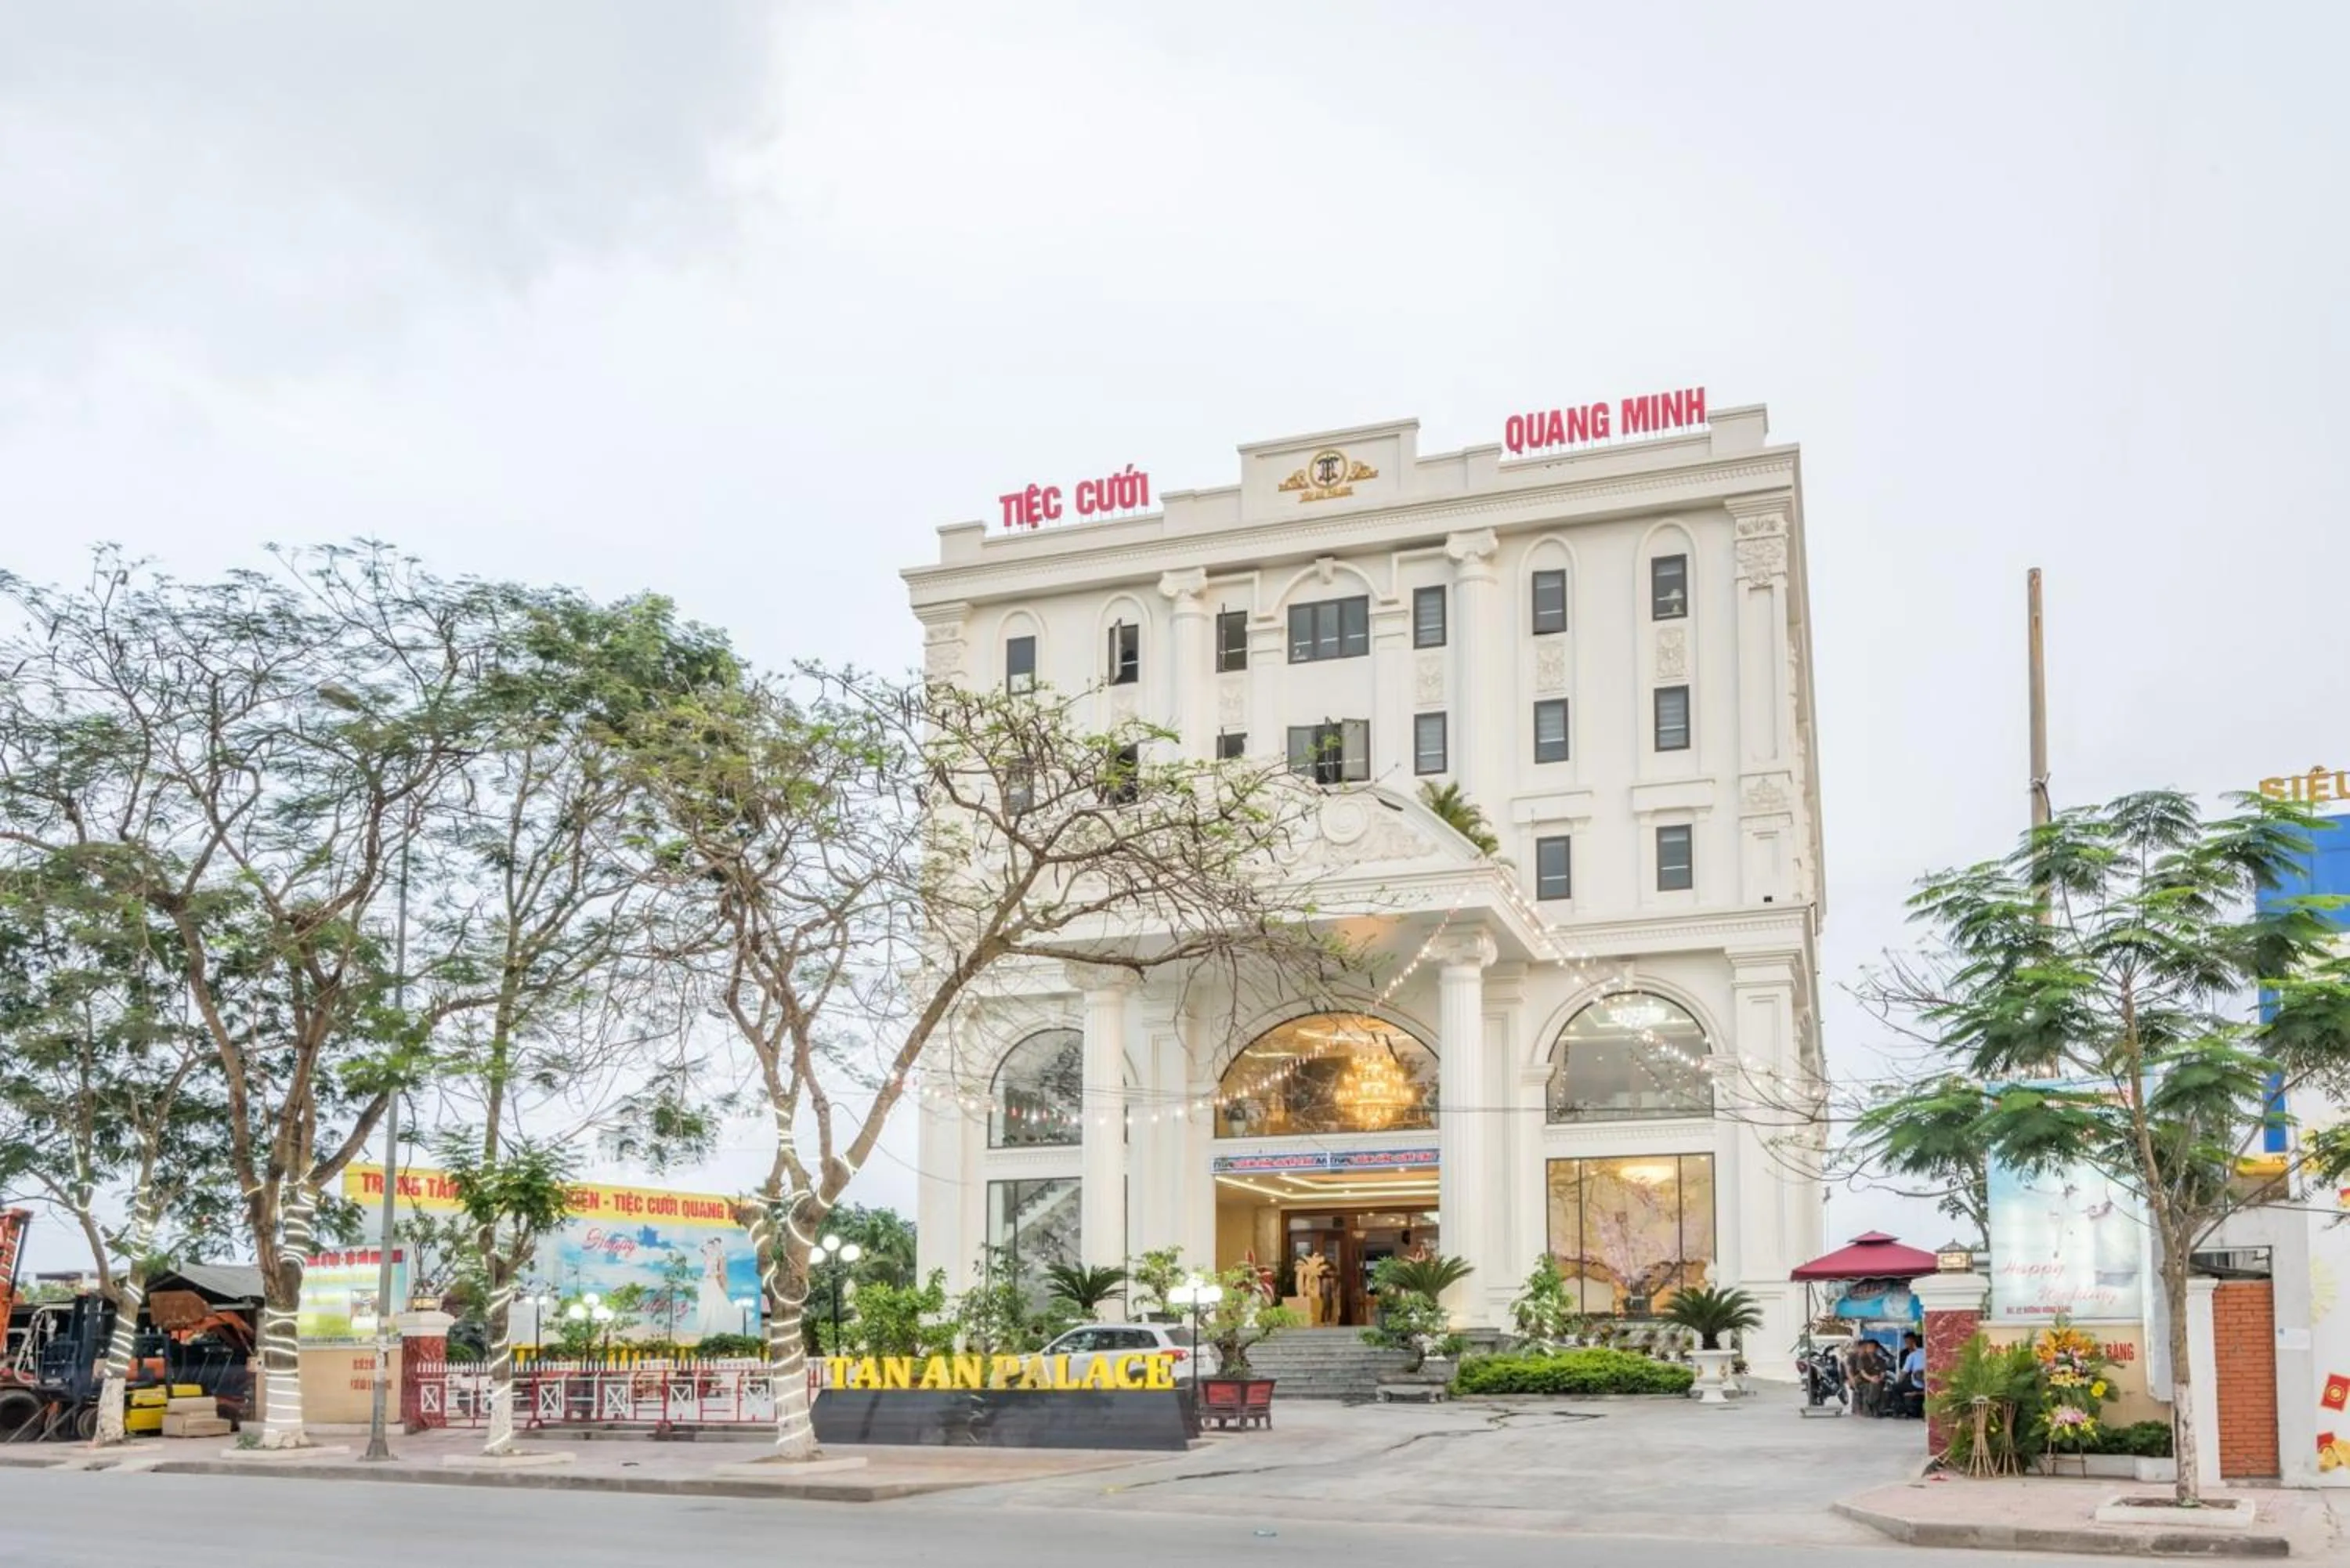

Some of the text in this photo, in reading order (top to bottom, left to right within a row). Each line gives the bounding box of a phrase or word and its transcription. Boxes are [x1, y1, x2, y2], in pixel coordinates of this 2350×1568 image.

[1505, 386, 1705, 454] QUANG MINH
[999, 463, 1149, 529] TIỆC CƯỚI
[361, 1172, 421, 1197] TRNG
[614, 1190, 643, 1216] TIỆC
[648, 1194, 678, 1216] CƯỚI
[682, 1200, 725, 1219] QUANG
[918, 1353, 983, 1389] AN
[989, 1353, 1176, 1389] PALACE
